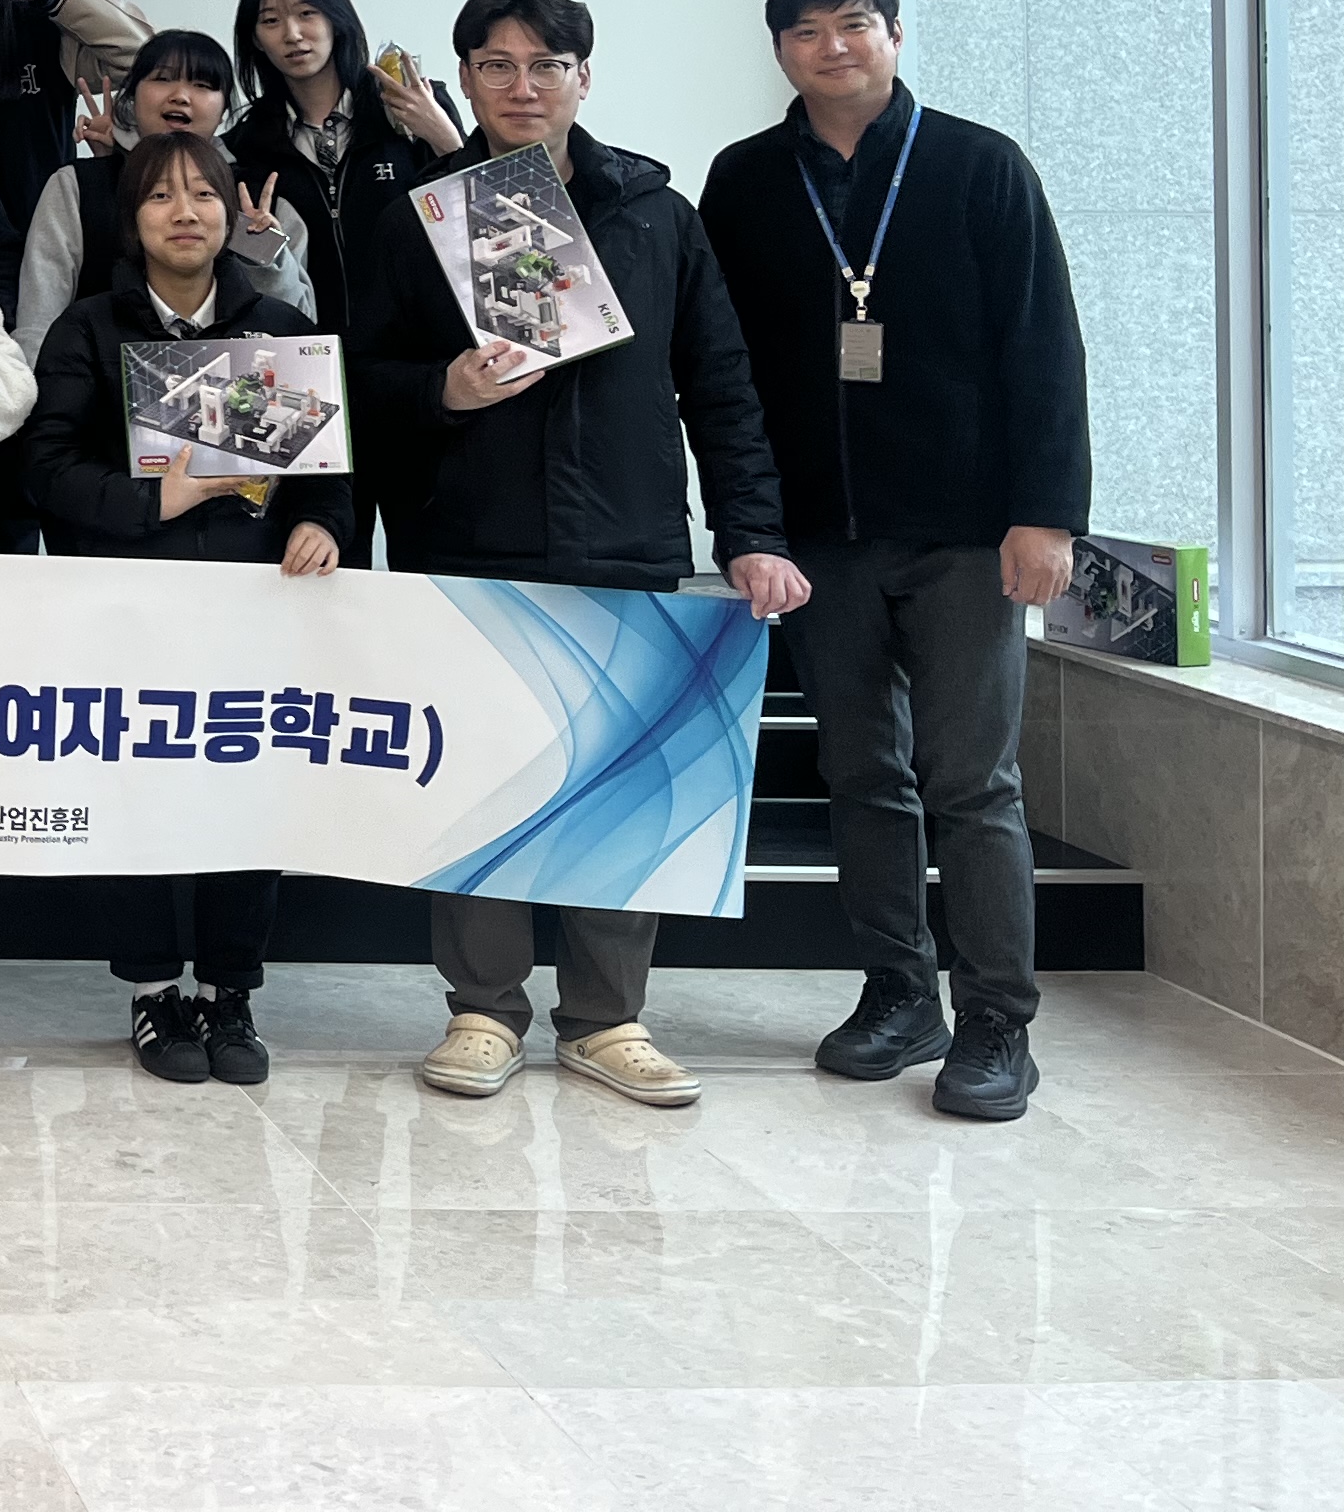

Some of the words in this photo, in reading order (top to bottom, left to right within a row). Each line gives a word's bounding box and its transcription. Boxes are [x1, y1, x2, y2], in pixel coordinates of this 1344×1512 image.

[373, 163, 395, 181] H
[598, 303, 620, 334] KIMS
[299, 343, 331, 356] KIMS
[20, 834, 61, 844] Promotion
[62, 835, 89, 846] Agency
